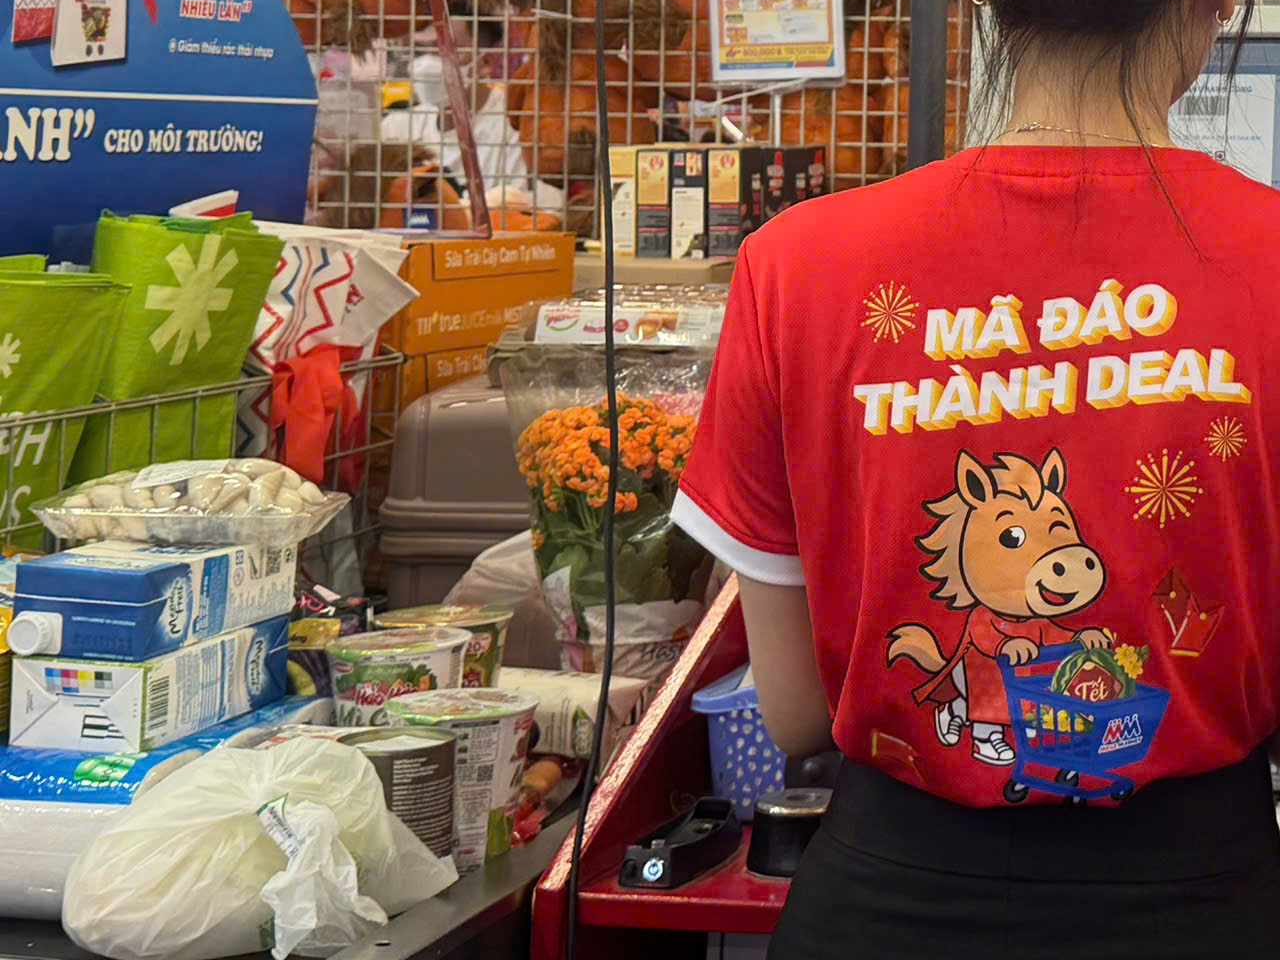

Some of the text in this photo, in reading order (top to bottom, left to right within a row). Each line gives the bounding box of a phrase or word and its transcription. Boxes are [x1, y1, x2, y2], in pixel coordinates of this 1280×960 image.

[104, 128, 144, 153] CHO
[146, 122, 183, 153] MÔI
[186, 123, 264, 153] TRƯỜNG!
[923, 278, 1178, 361] MÃ ĐÁO
[853, 348, 1252, 436] THÀNH DEAL
[1074, 675, 1109, 702] Tết
